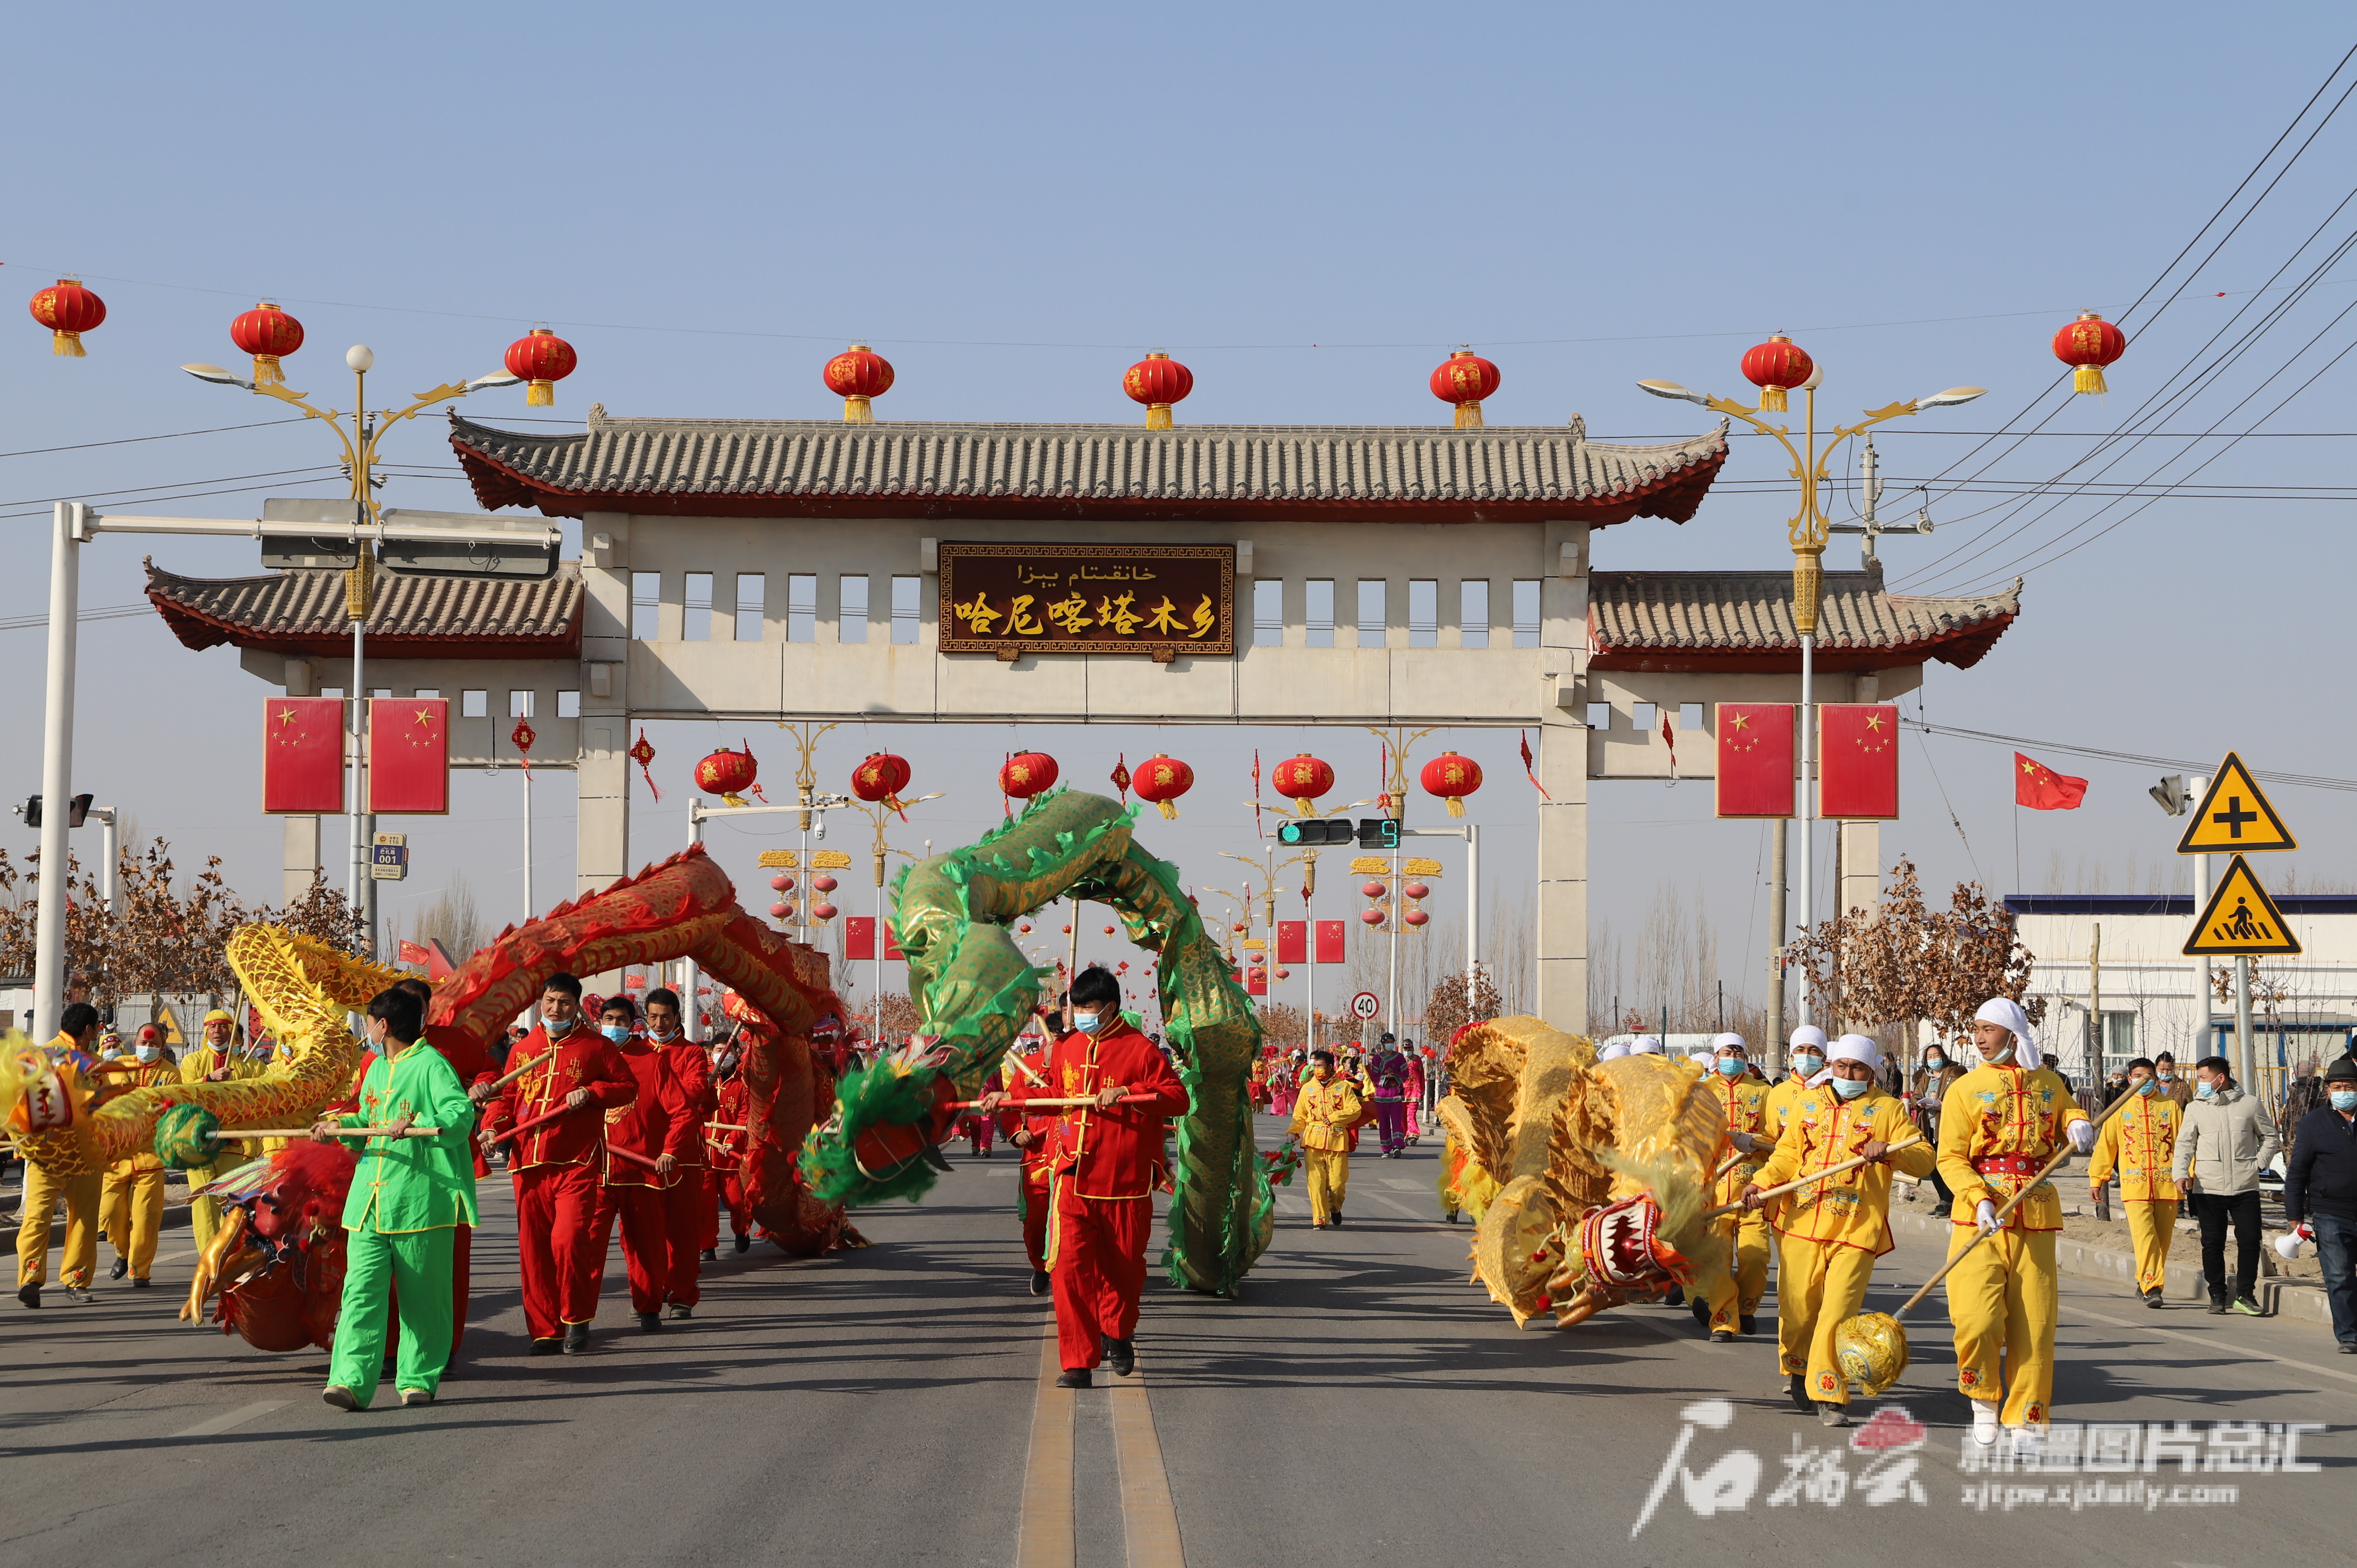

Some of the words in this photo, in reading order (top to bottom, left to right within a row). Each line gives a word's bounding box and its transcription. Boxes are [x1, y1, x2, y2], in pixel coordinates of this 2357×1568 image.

[954, 590, 1215, 638] 哈尼喀塔木乡
[1381, 820, 1398, 848] 9
[379, 855, 396, 864] 001
[1358, 998, 1373, 1013] 40
[1822, 1375, 1835, 1390] 福
[1961, 1371, 1975, 1384] 福
[2028, 1406, 2040, 1422] 福
